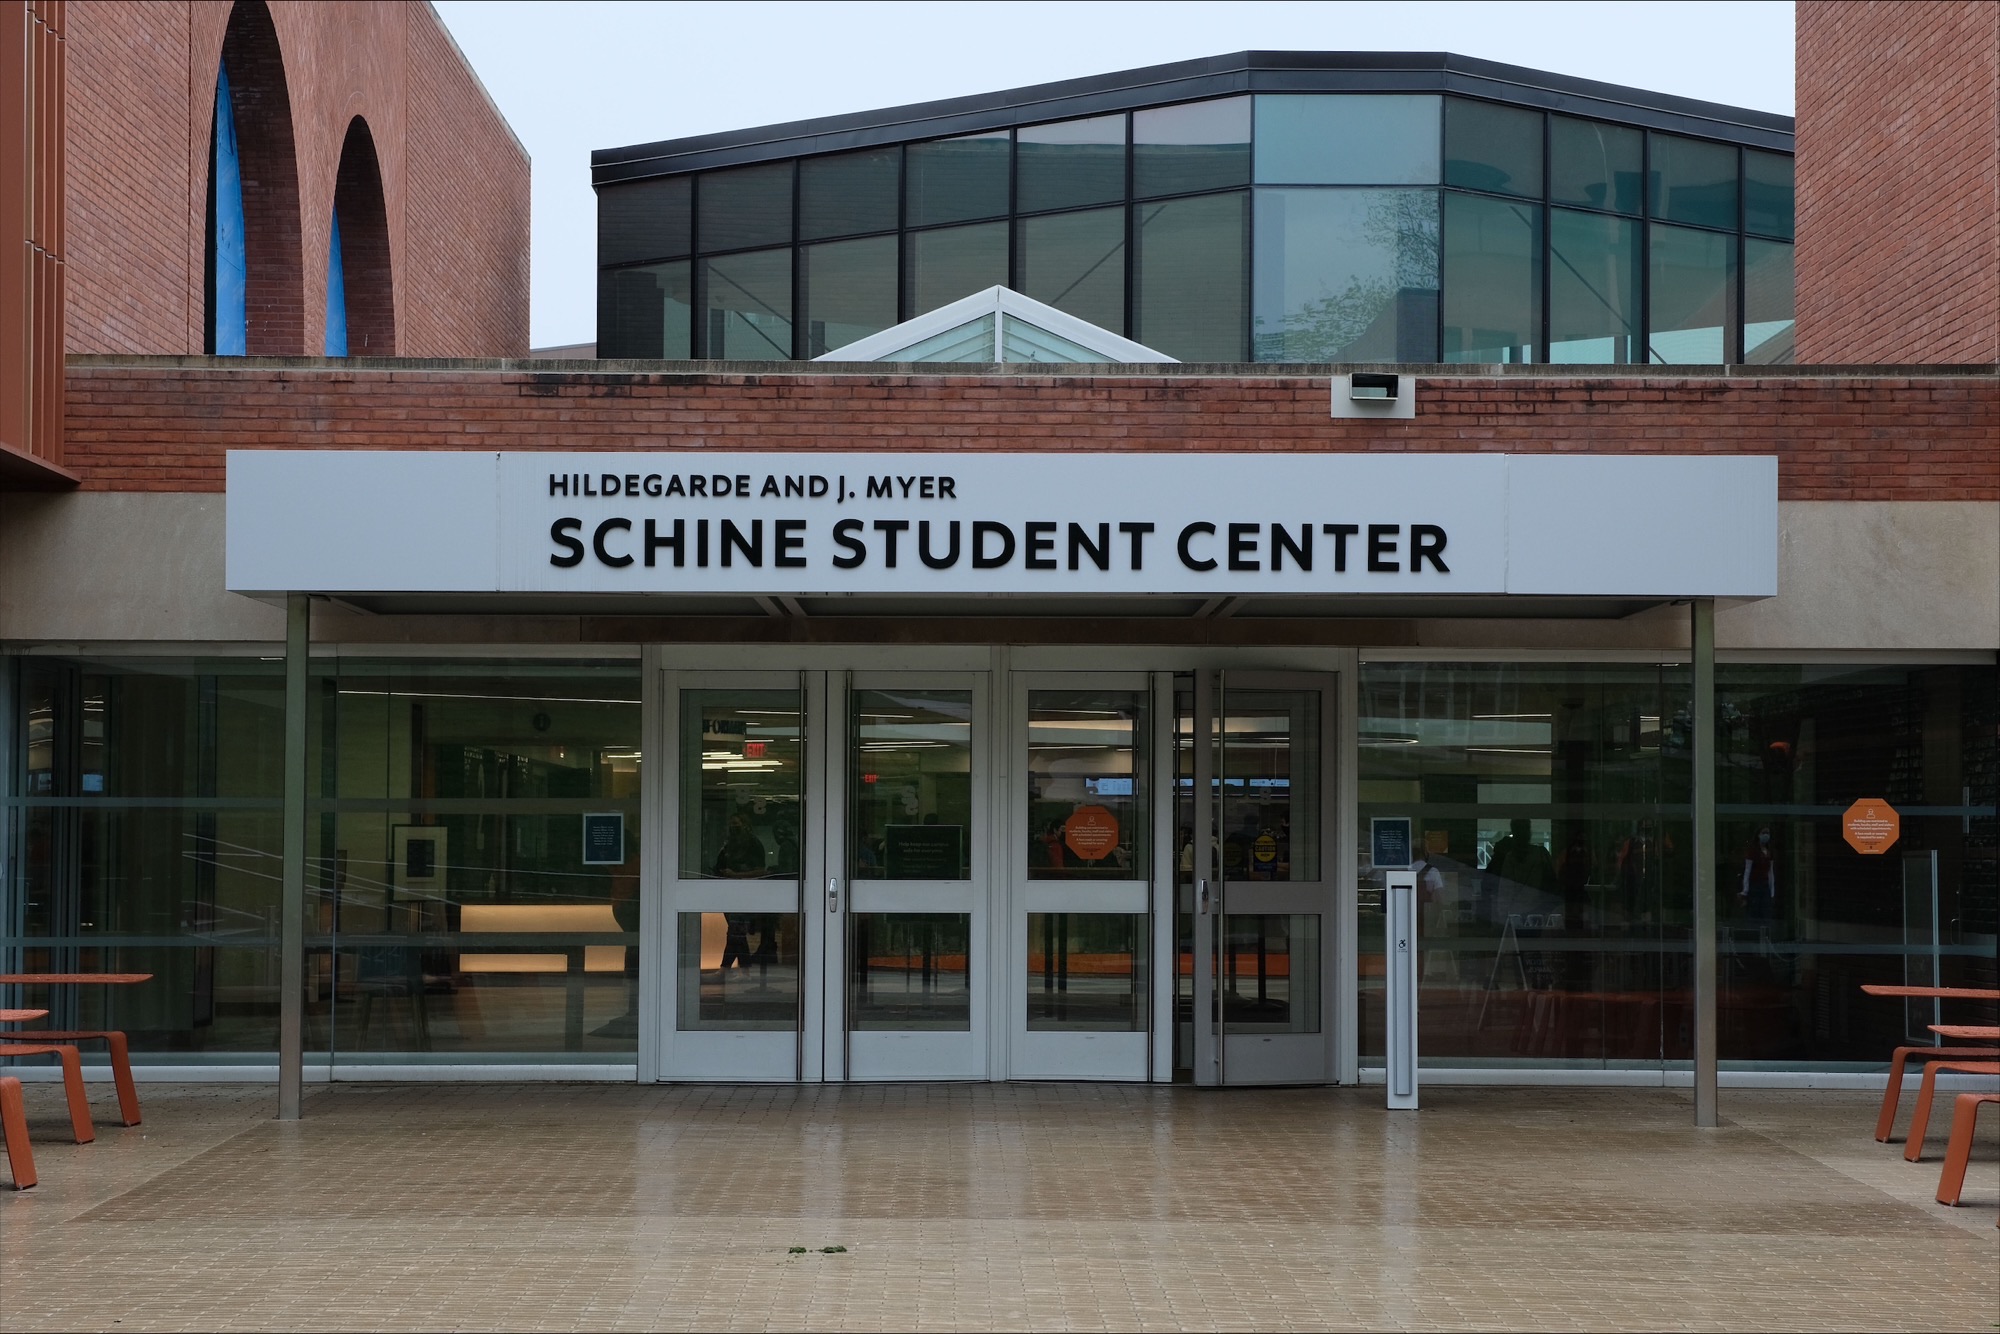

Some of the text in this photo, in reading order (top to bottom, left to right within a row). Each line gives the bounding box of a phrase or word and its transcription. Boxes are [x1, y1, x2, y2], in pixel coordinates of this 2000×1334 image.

[549, 474, 957, 503] HILDEGARDE AND J. MYER
[550, 517, 1450, 573] SCHINE STUDENT CENTER
[747, 743, 765, 758] EXIT
[865, 774, 877, 783] EXIT
